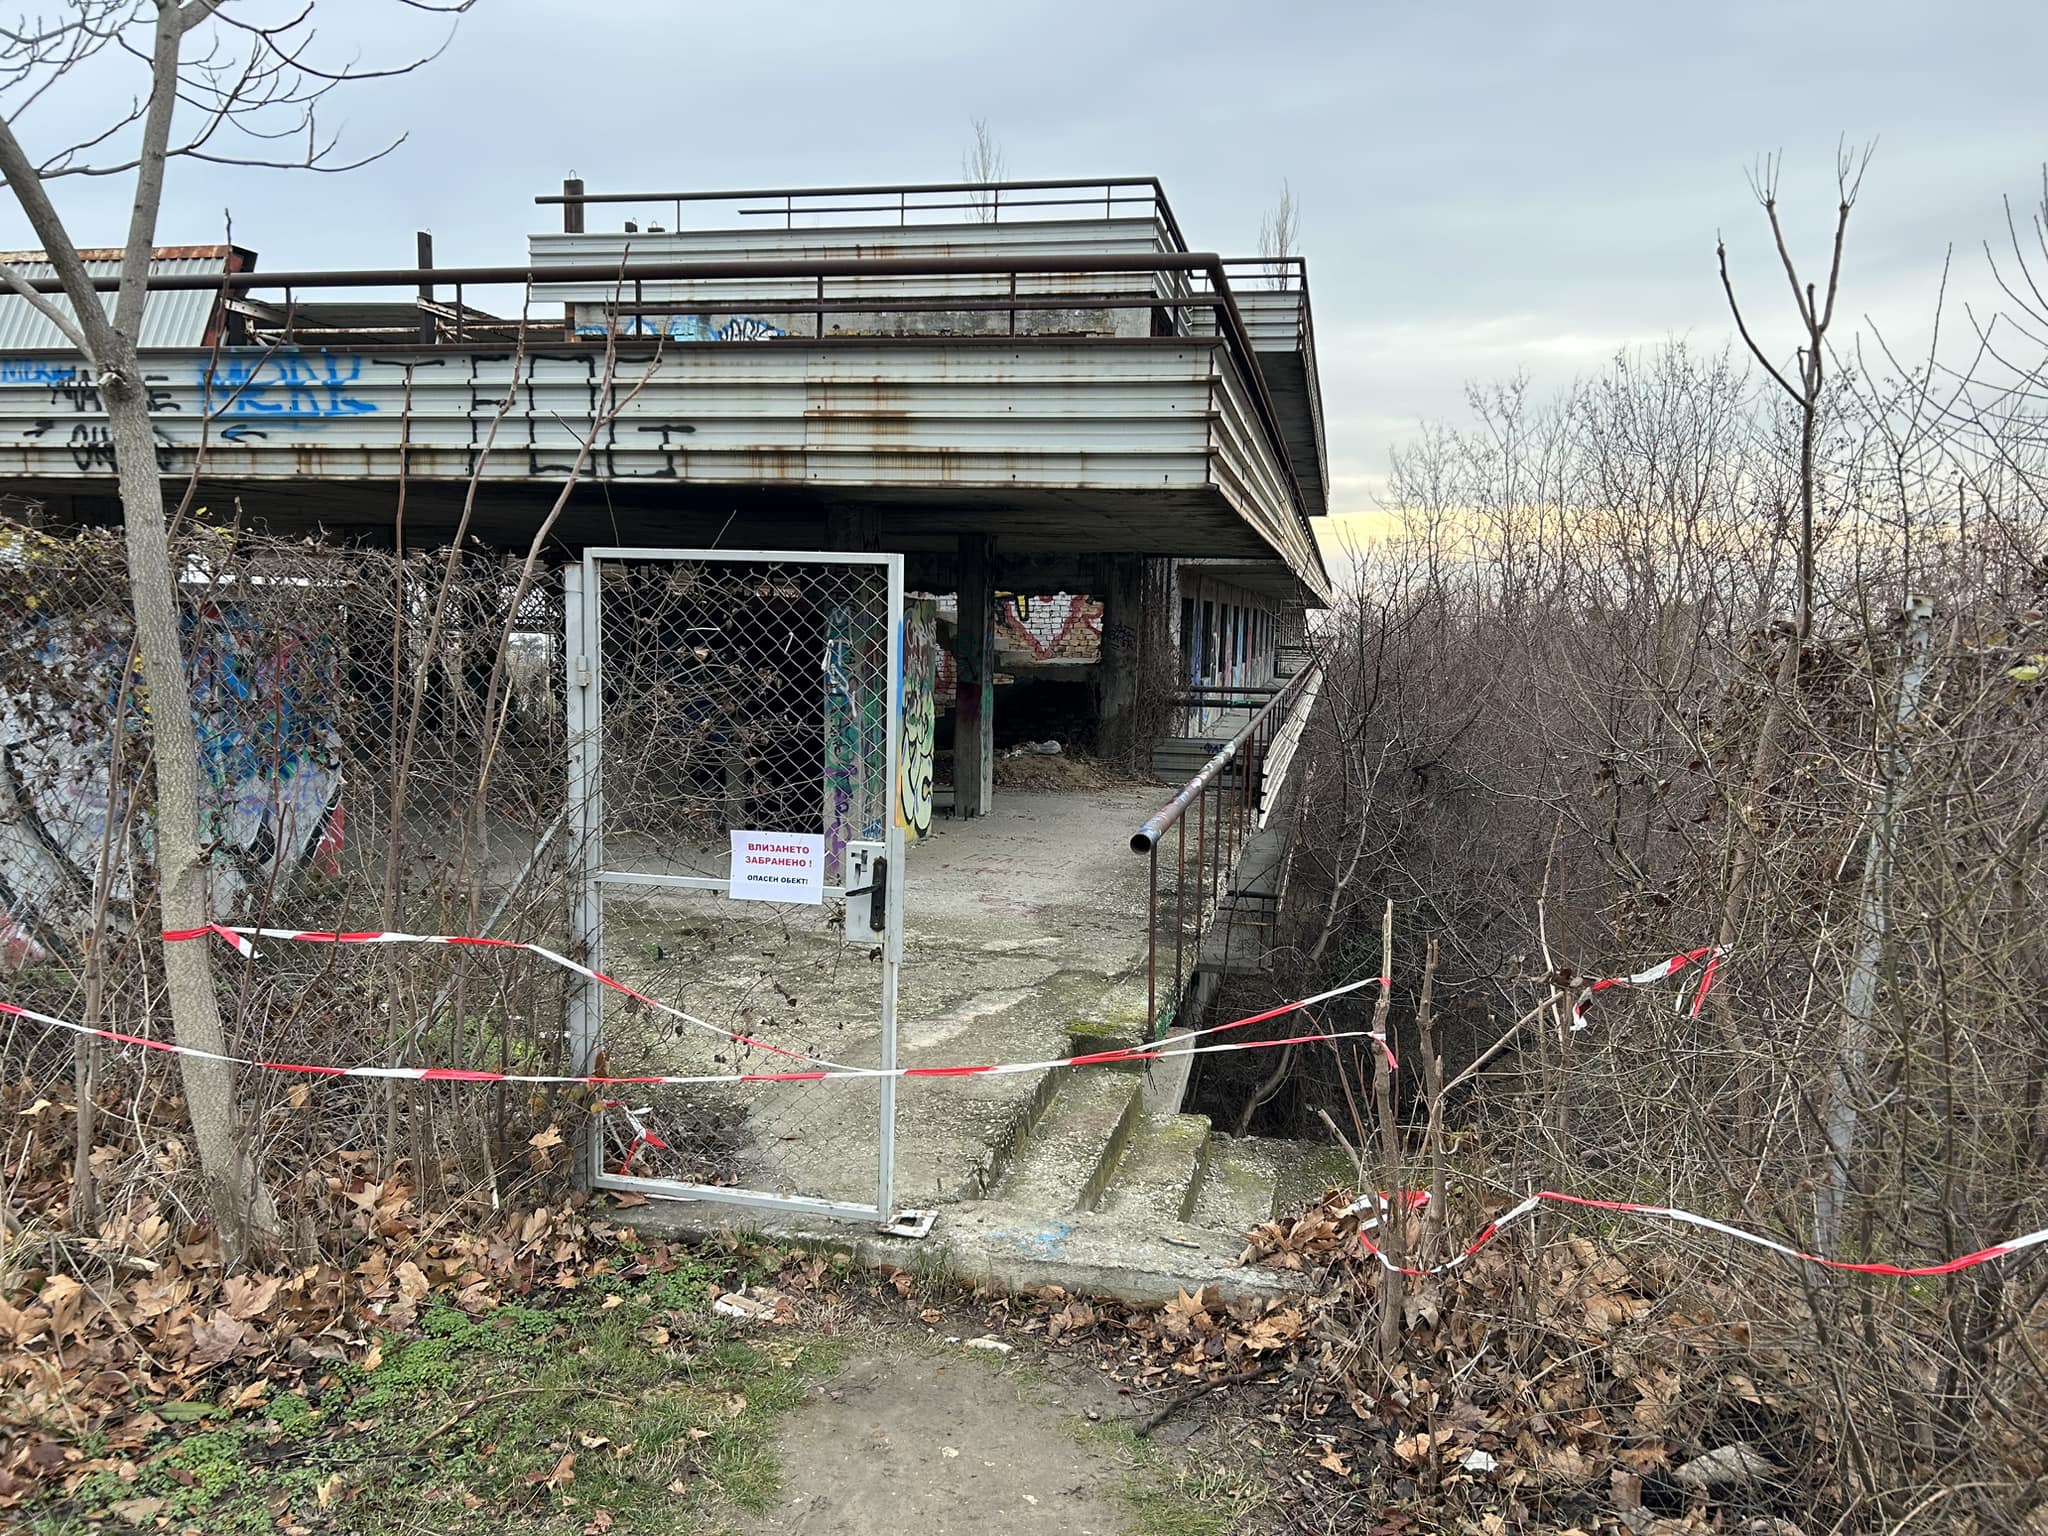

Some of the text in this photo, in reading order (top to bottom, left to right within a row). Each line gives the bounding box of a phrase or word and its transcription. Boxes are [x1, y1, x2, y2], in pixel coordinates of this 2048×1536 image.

[748, 843, 810, 854] ВЛИЗАНЕТО
[745, 856, 806, 867] ЗАБРАНЕНО
[747, 874, 808, 885] ОПАСЕН ОБЕКТ!
